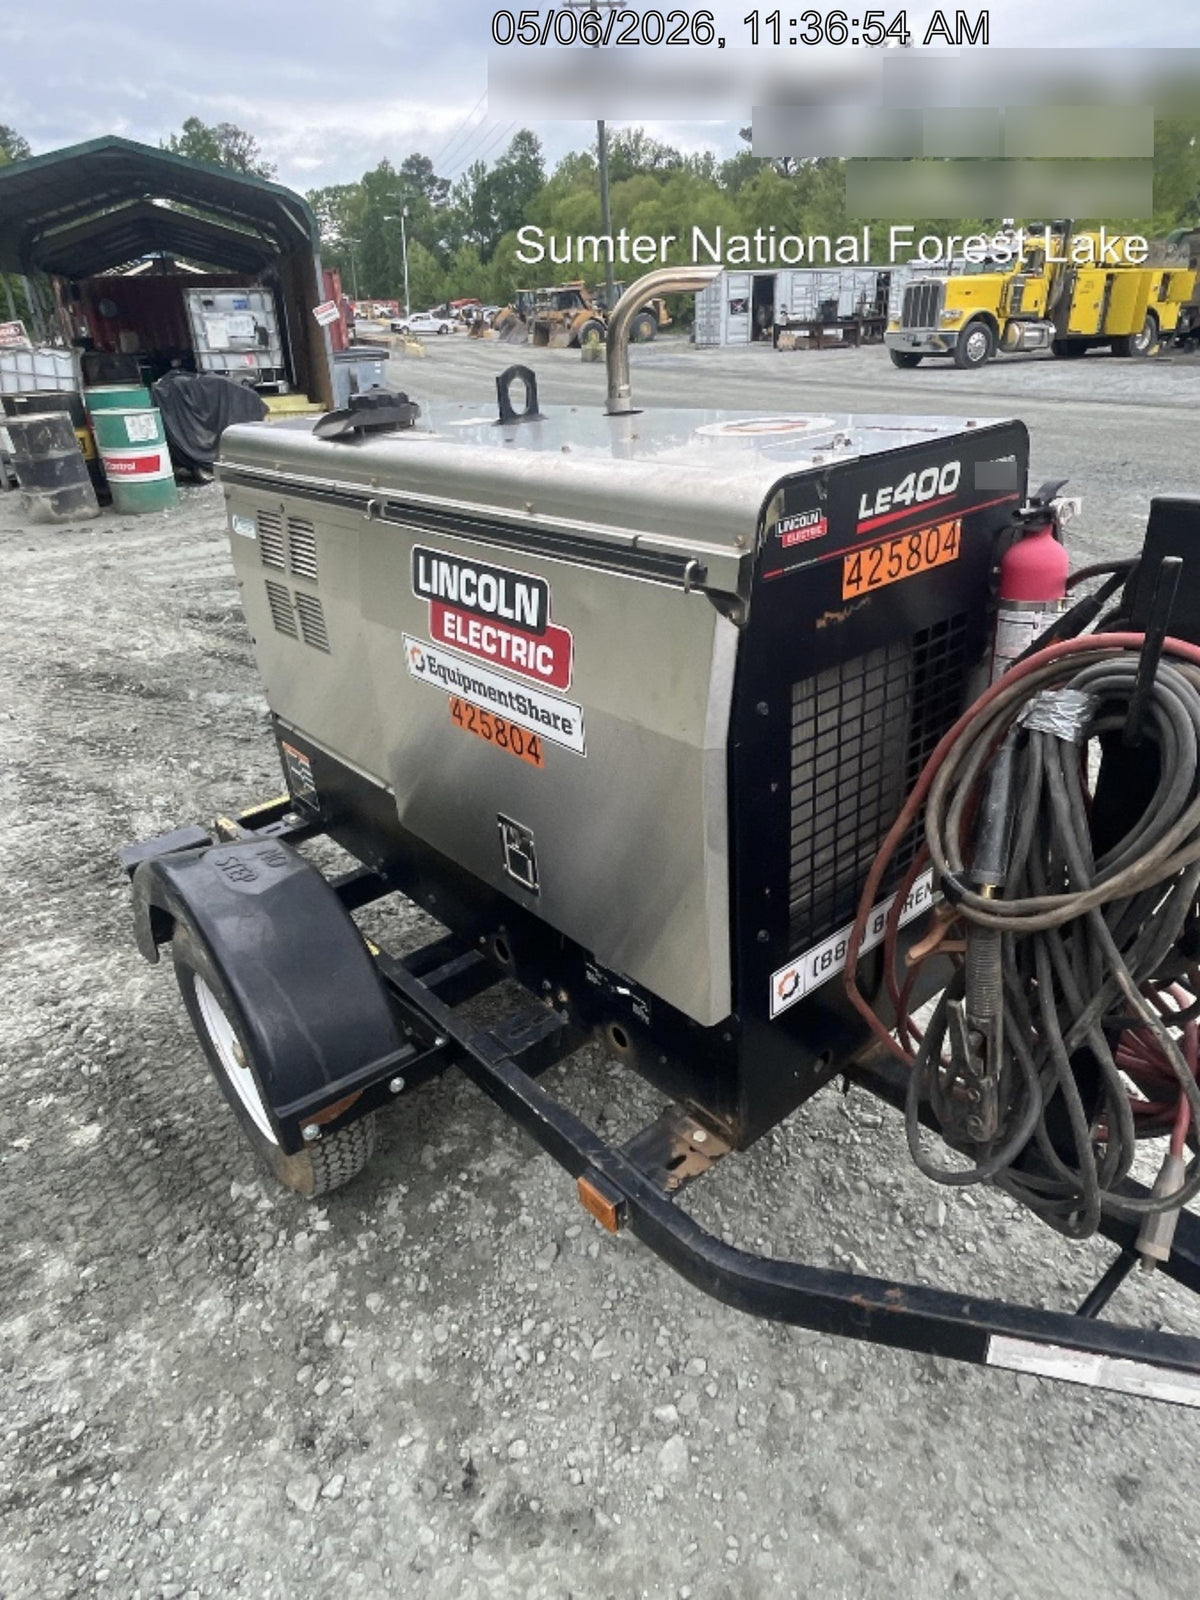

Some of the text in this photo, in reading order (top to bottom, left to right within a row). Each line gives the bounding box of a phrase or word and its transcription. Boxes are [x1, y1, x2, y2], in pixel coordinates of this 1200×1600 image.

[858, 460, 961, 520] LE400
[777, 511, 820, 535] LINCOLN
[786, 523, 824, 544] ELECTRIC
[846, 526, 957, 591] 425804
[418, 555, 540, 627] LINCOLN
[443, 611, 554, 675] ELECTRIC
[426, 654, 573, 736] EquipmentShare
[452, 699, 541, 765] 425804
[214, 856, 259, 883] STEP
